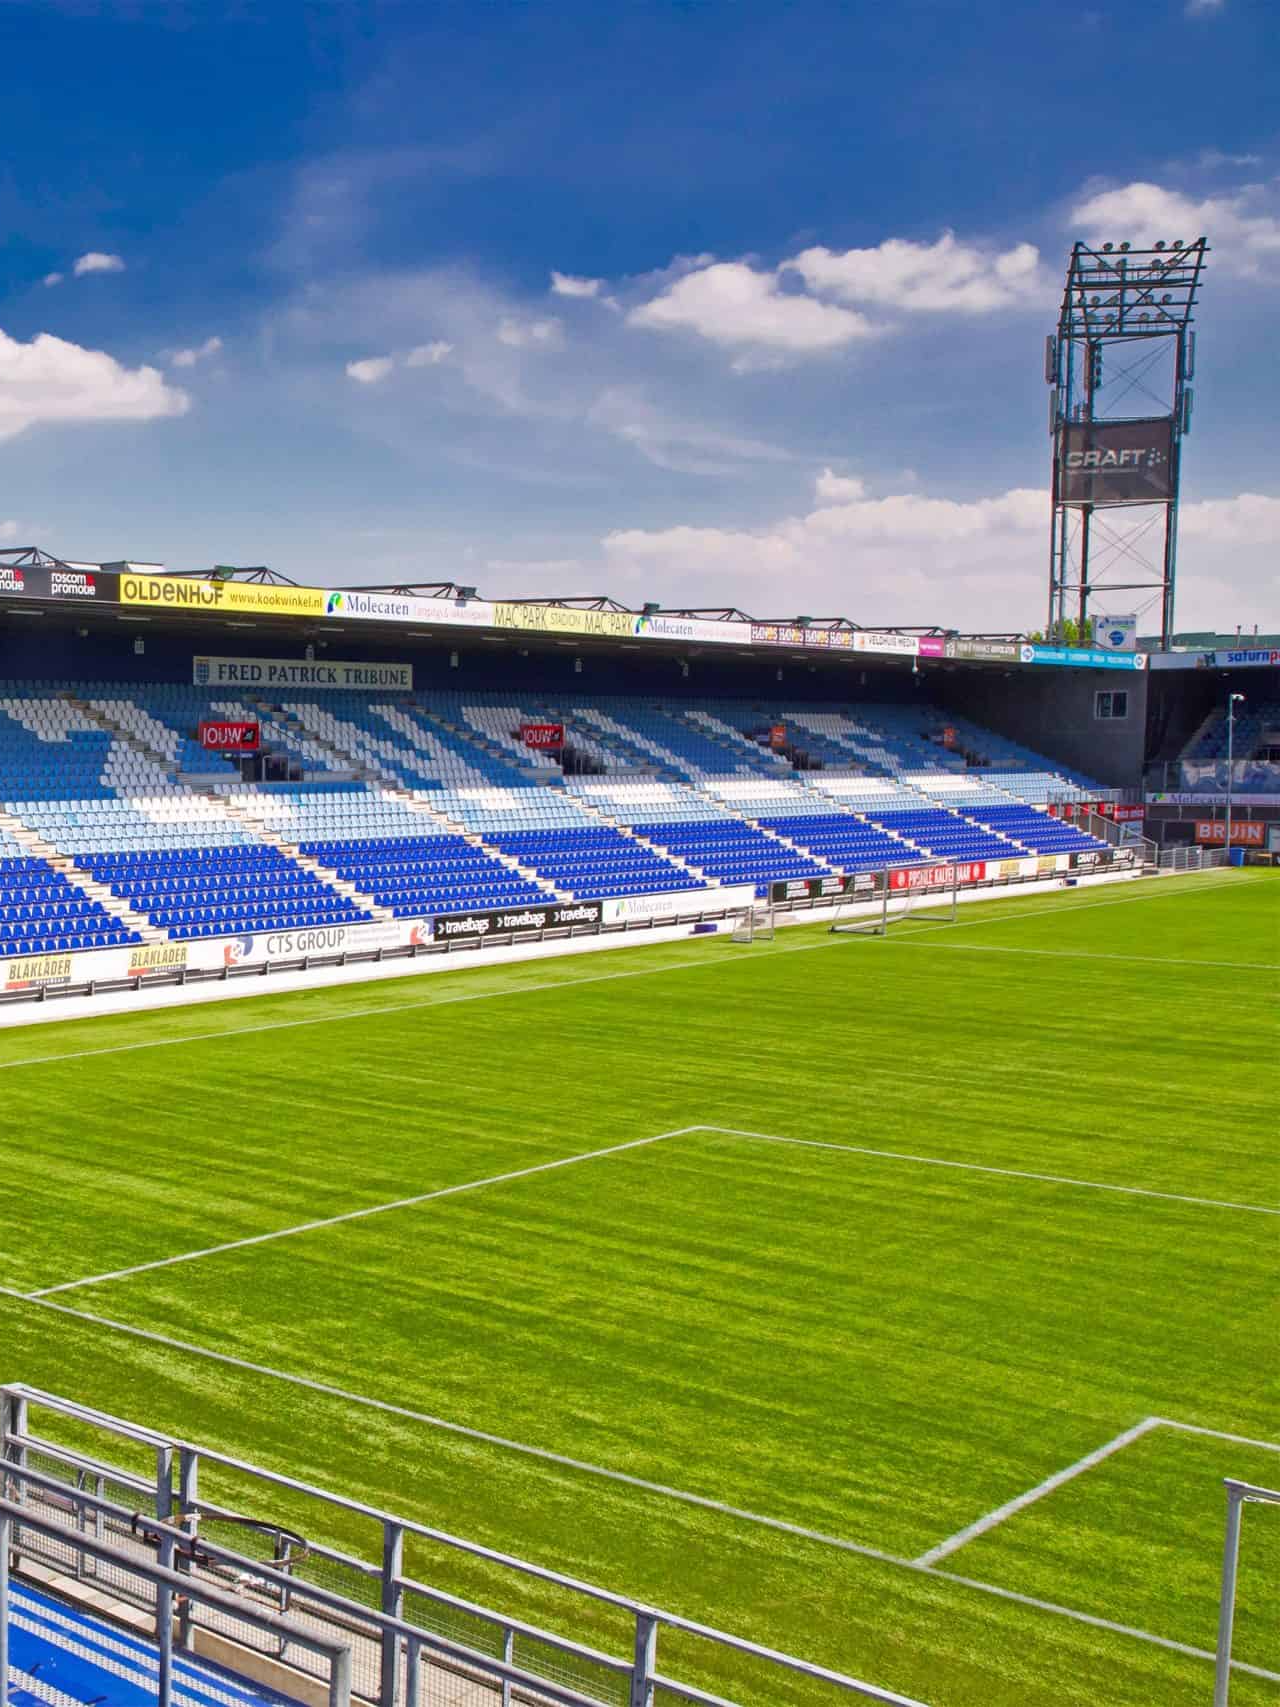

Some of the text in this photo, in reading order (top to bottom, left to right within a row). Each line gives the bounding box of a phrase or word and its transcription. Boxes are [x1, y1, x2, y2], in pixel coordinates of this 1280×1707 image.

[1066, 449, 1146, 467] CRAFT
[51, 572, 87, 584] roscom
[51, 583, 95, 595] promotie
[230, 591, 323, 609] www.kookwinkel.nl
[347, 595, 409, 615] Molecaten
[649, 618, 693, 635] Molecaten
[1227, 651, 1280, 664] saturnp
[218, 663, 409, 686] FRED PATRICK TRIBUNE
[504, 911, 546, 927] travelbags
[560, 905, 598, 921] travelbags
[445, 917, 490, 934] travelbags
[266, 935, 293, 954] CTS
[297, 928, 345, 951] GROUP
